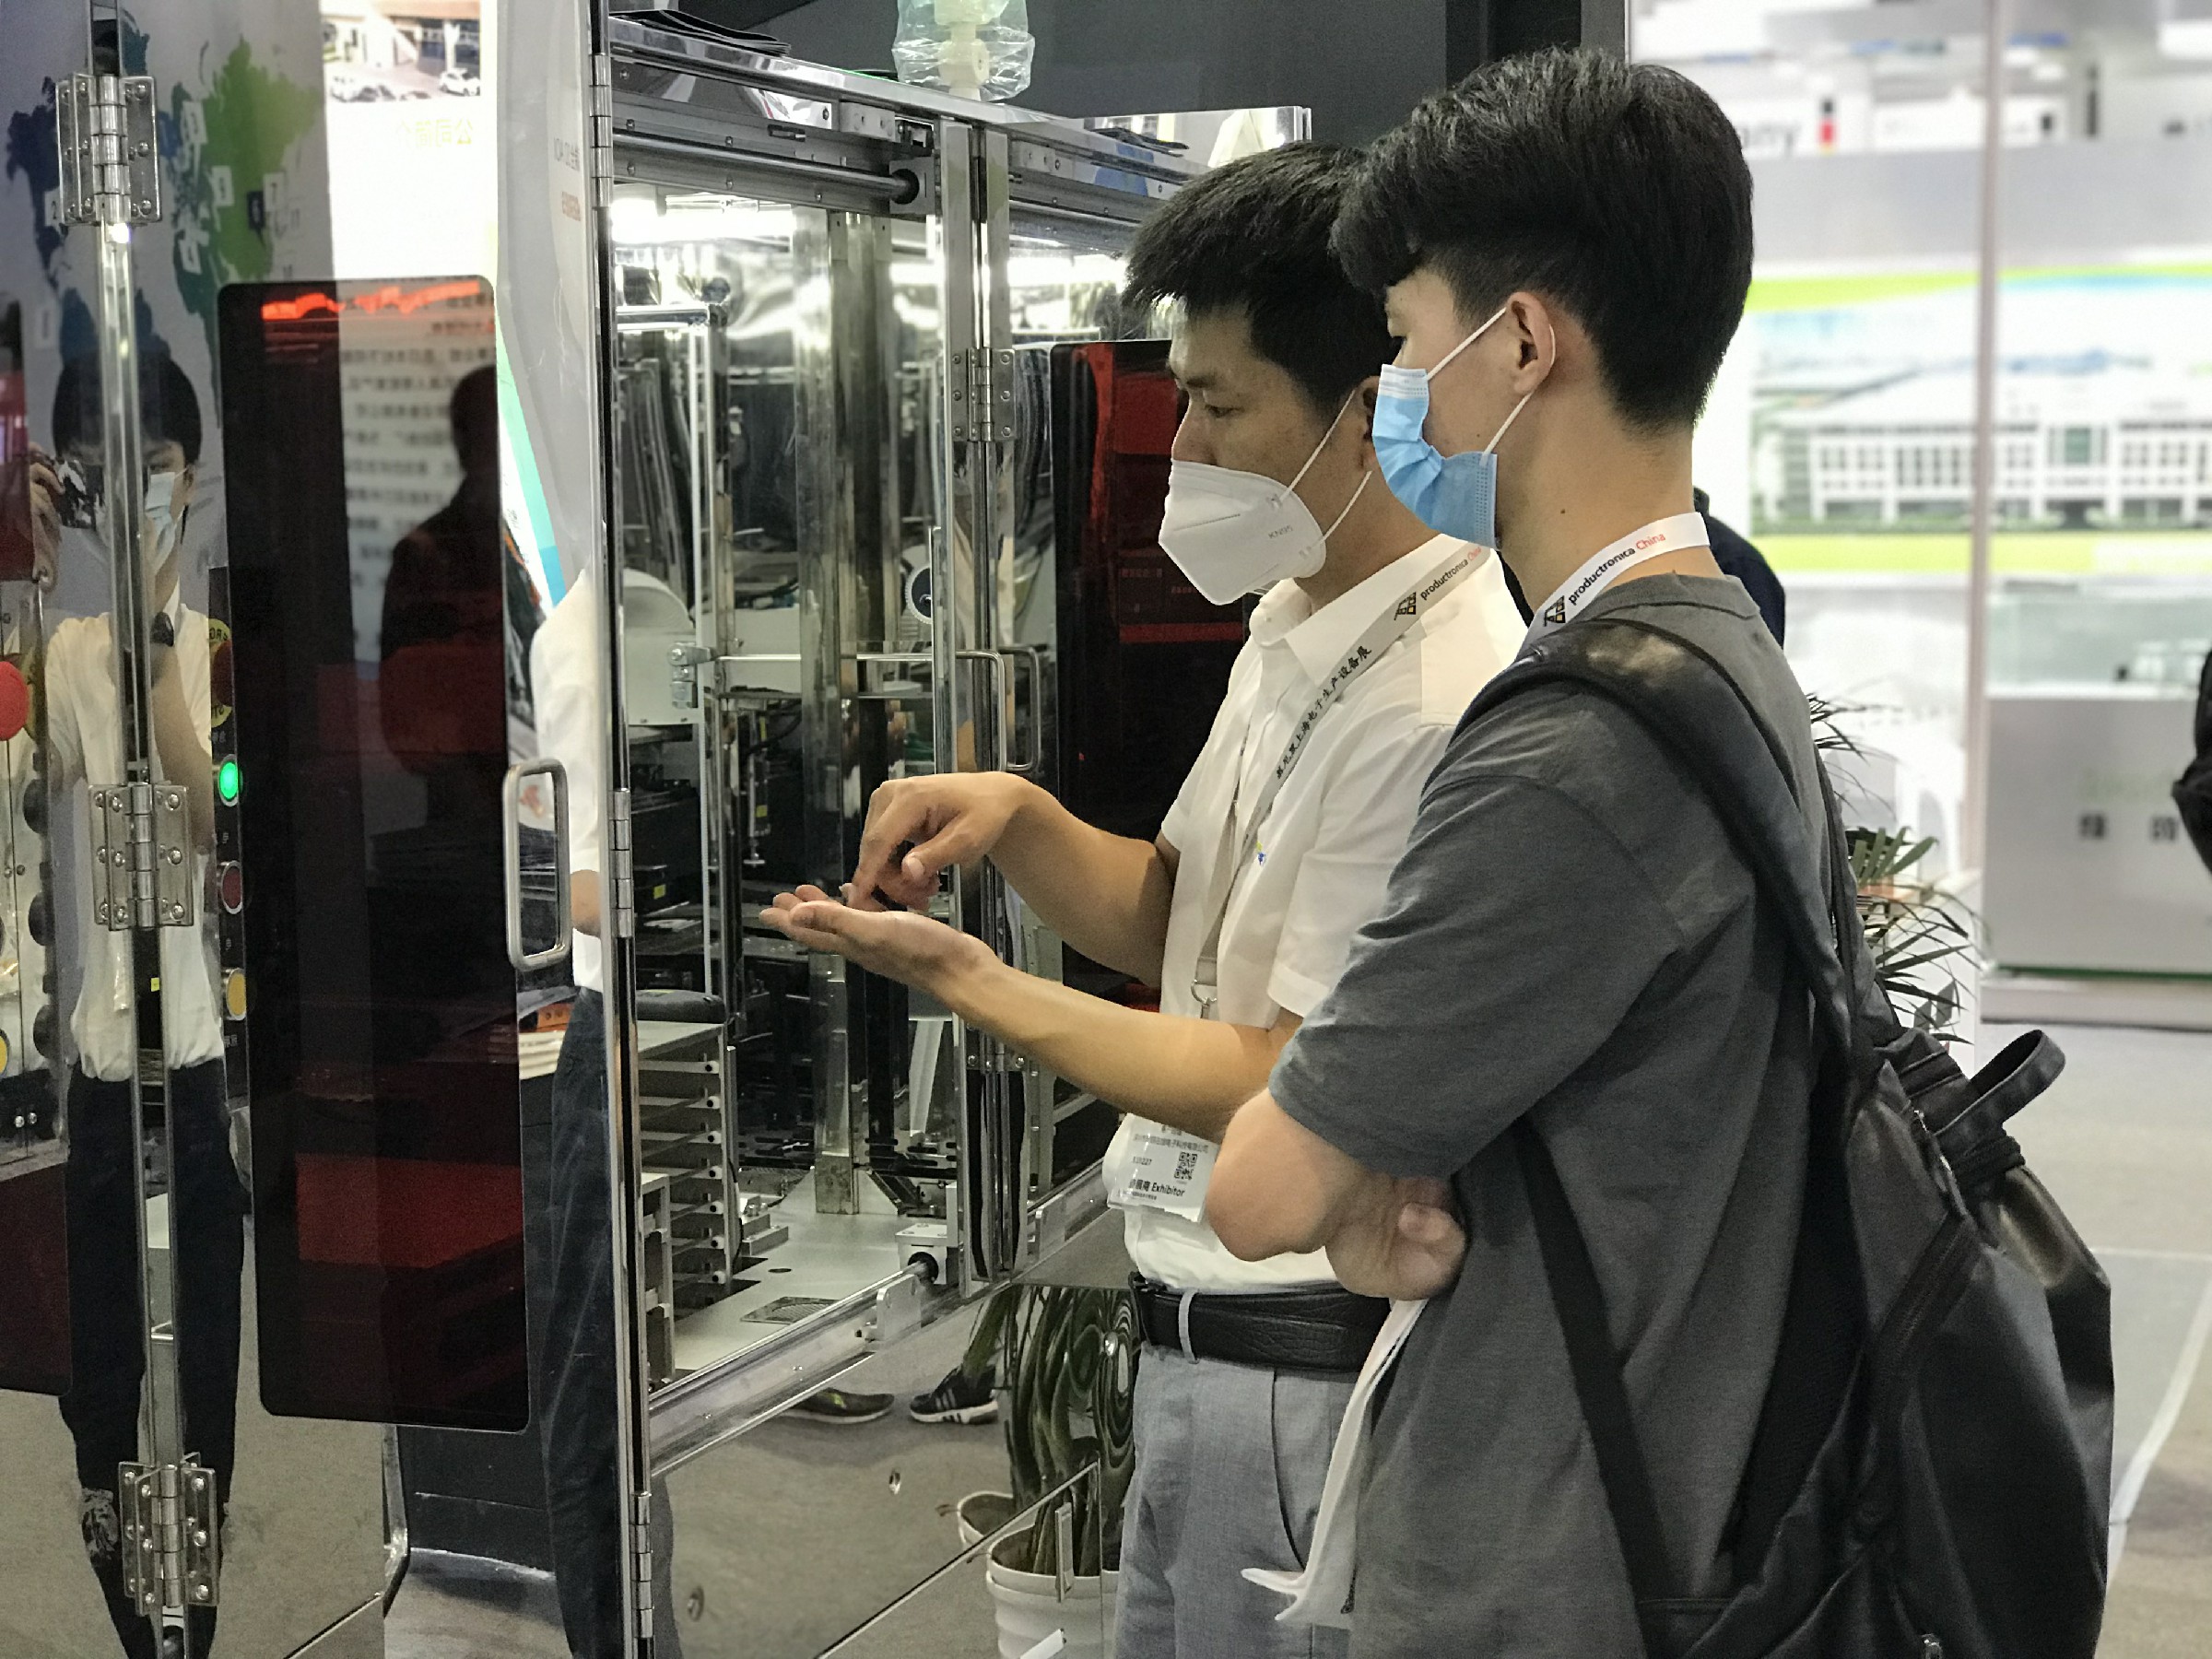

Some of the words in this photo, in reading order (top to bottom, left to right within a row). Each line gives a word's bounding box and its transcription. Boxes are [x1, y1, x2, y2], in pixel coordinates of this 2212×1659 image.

[1420, 559, 1468, 601] productronica
[1568, 547, 1636, 606] productronica
[1636, 533, 1666, 550] China
[1151, 1182, 1186, 1196] Exhibitor
